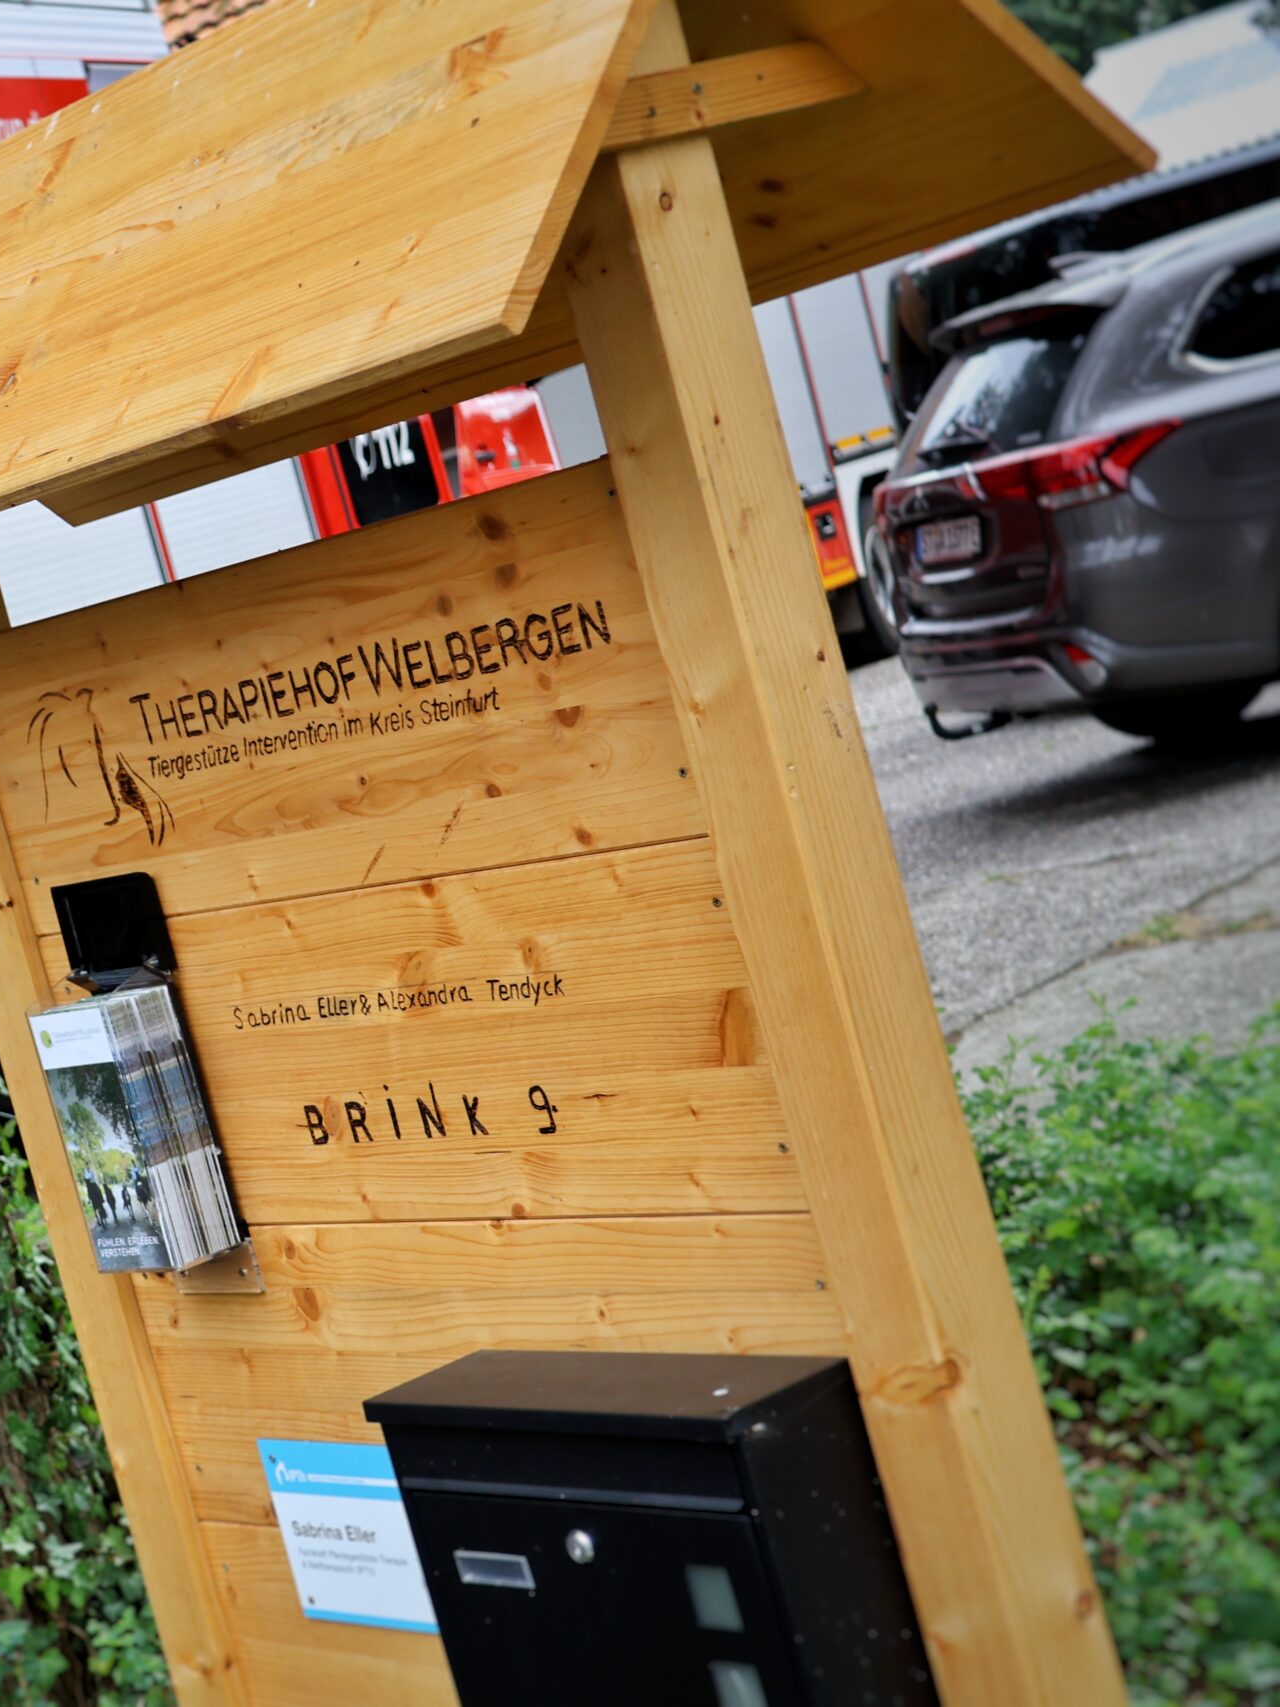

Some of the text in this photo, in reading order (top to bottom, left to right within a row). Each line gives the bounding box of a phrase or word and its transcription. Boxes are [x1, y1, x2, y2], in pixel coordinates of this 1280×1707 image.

[129, 600, 612, 745] THERAPIEHOF WELBERGEN
[243, 720, 339, 757] Intervention
[341, 714, 364, 741] im
[370, 709, 415, 737] Kreis
[420, 686, 501, 725] Steinfurt
[234, 1001, 311, 1030] Sabrina
[377, 983, 473, 1012] Alexandra
[486, 973, 565, 1007] Tendyck
[291, 1519, 377, 1544] Sabrina Eller
